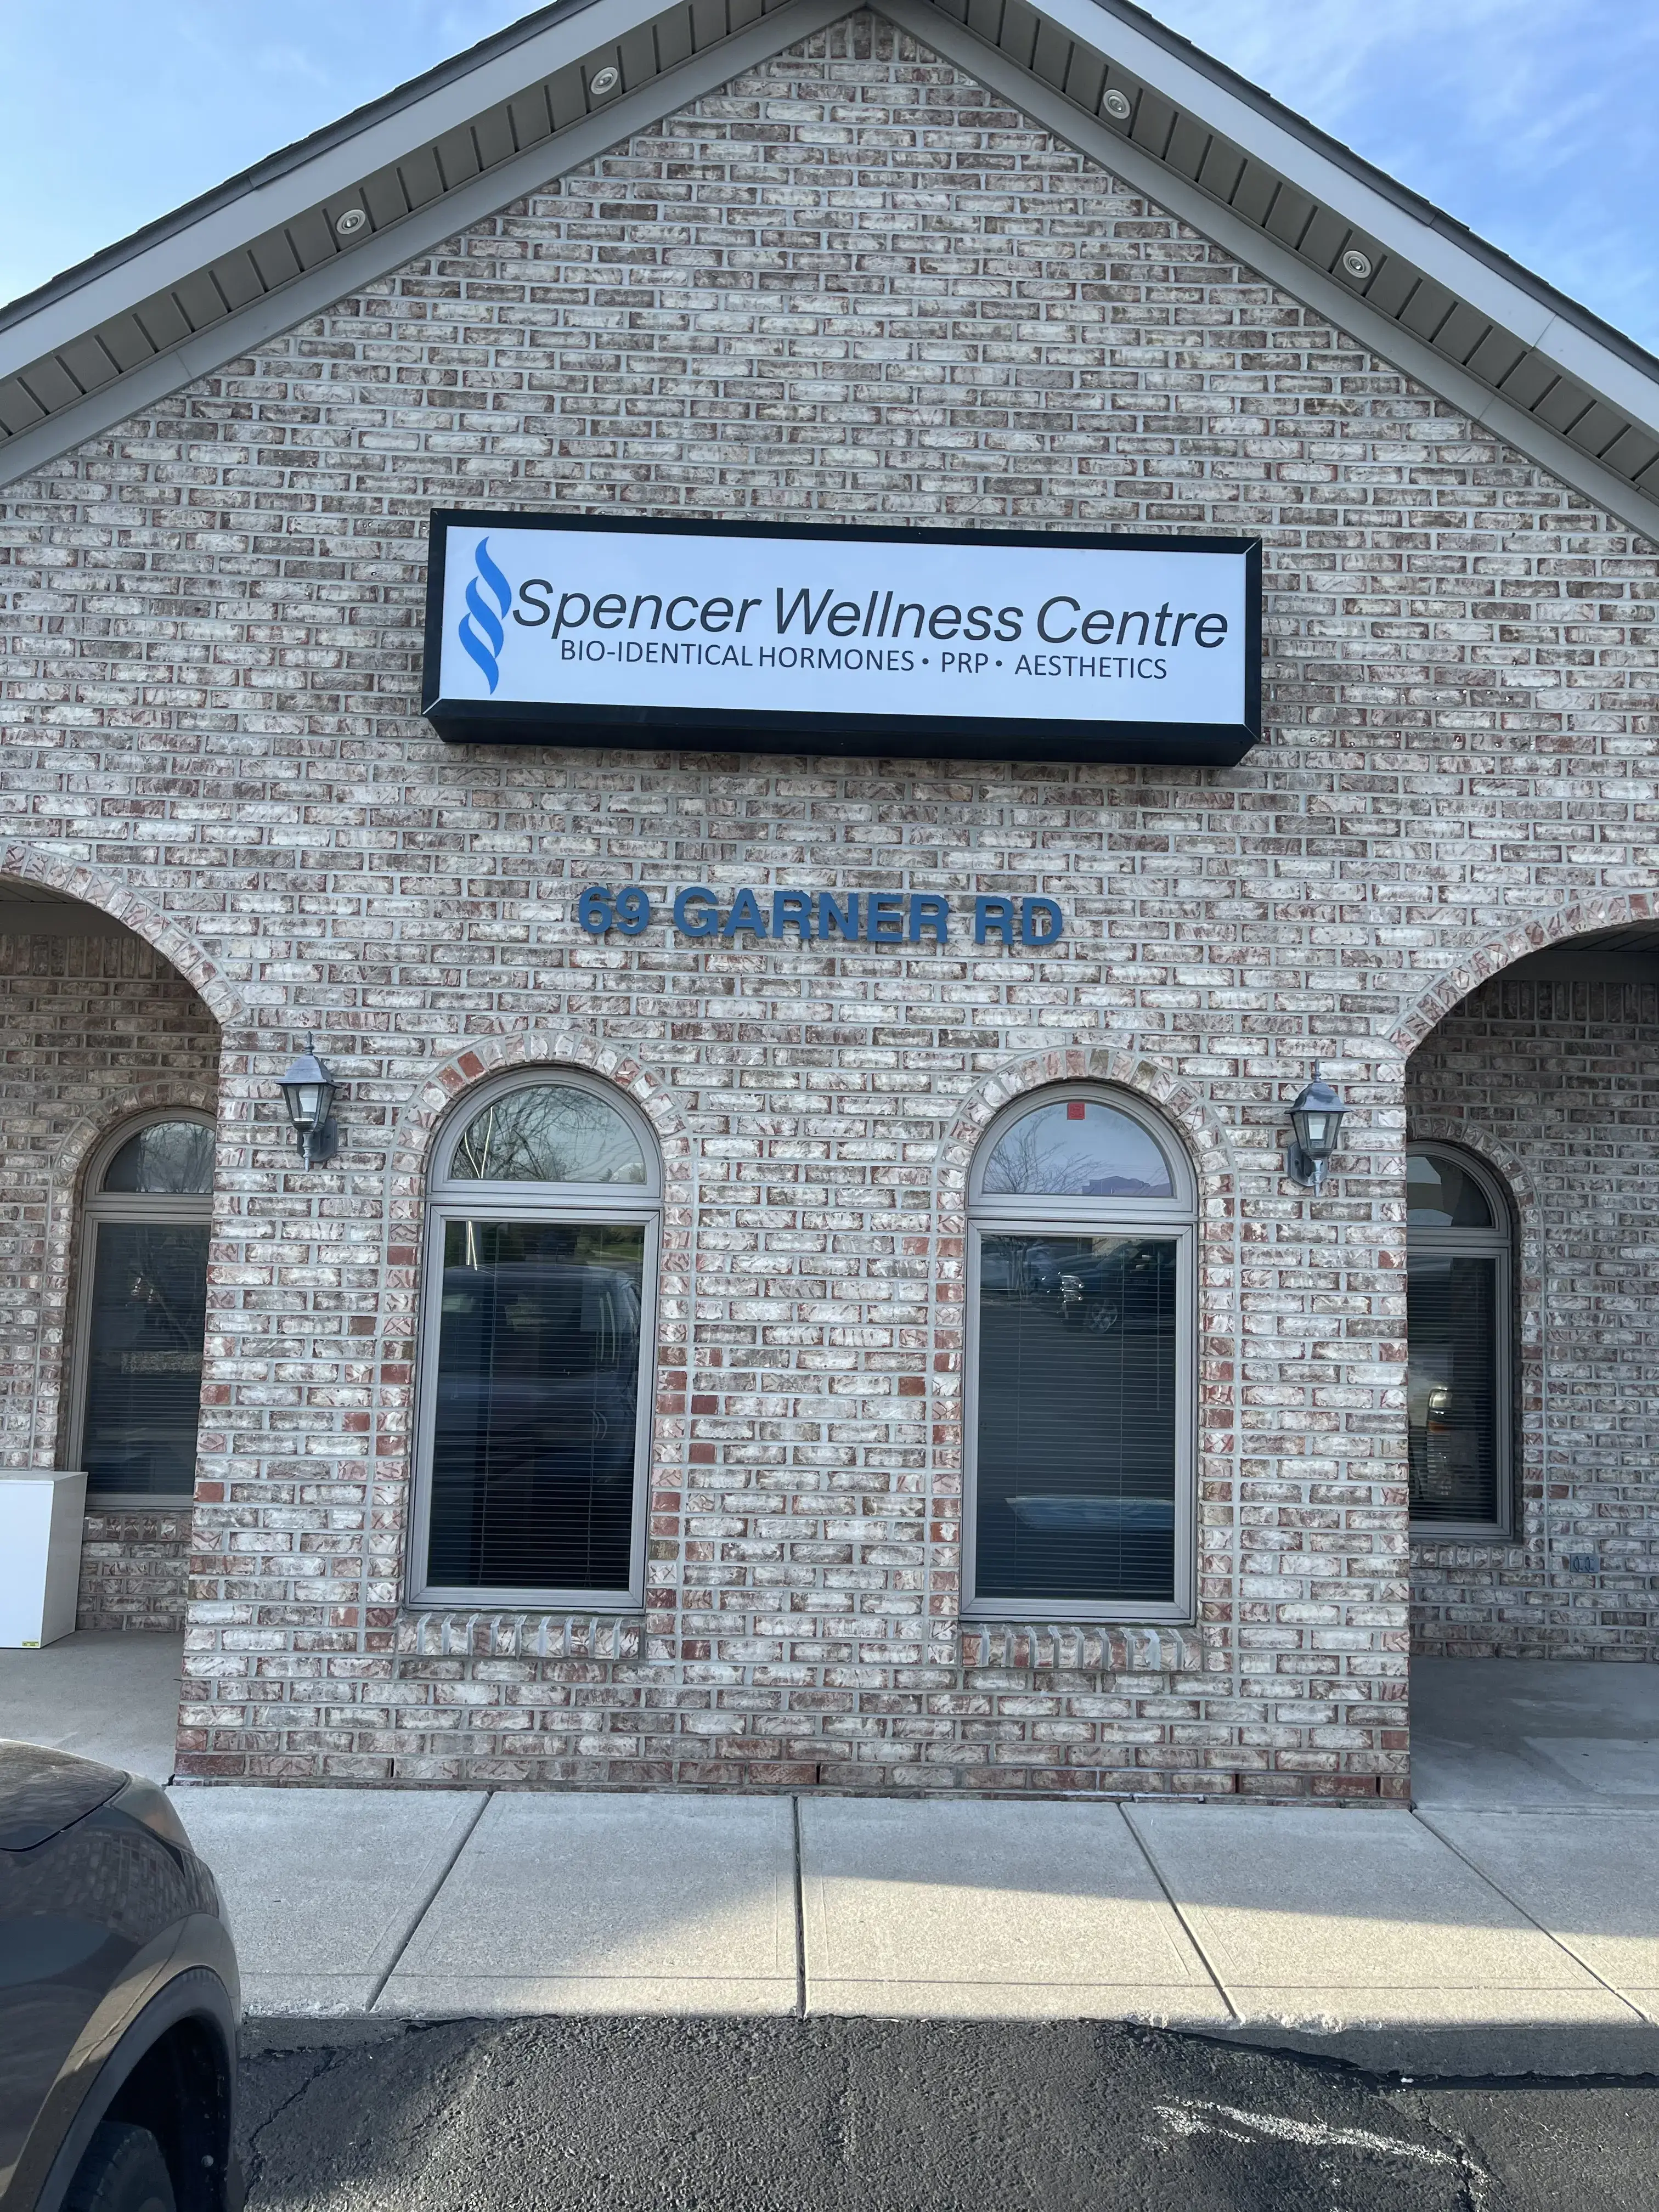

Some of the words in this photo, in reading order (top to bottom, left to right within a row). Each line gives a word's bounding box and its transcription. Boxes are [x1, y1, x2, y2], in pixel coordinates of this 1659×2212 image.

[512, 579, 763, 639] Spencer
[776, 587, 1024, 642] Wellness
[1037, 596, 1228, 648] Centre
[561, 640, 753, 667] BIO-IDENTICAL
[759, 646, 914, 672] HORMONES
[941, 652, 989, 673] PRP
[1014, 654, 1167, 679] AESTHETICS
[577, 886, 651, 935] 69
[673, 887, 951, 944] GARNER
[974, 895, 1063, 946] RD
